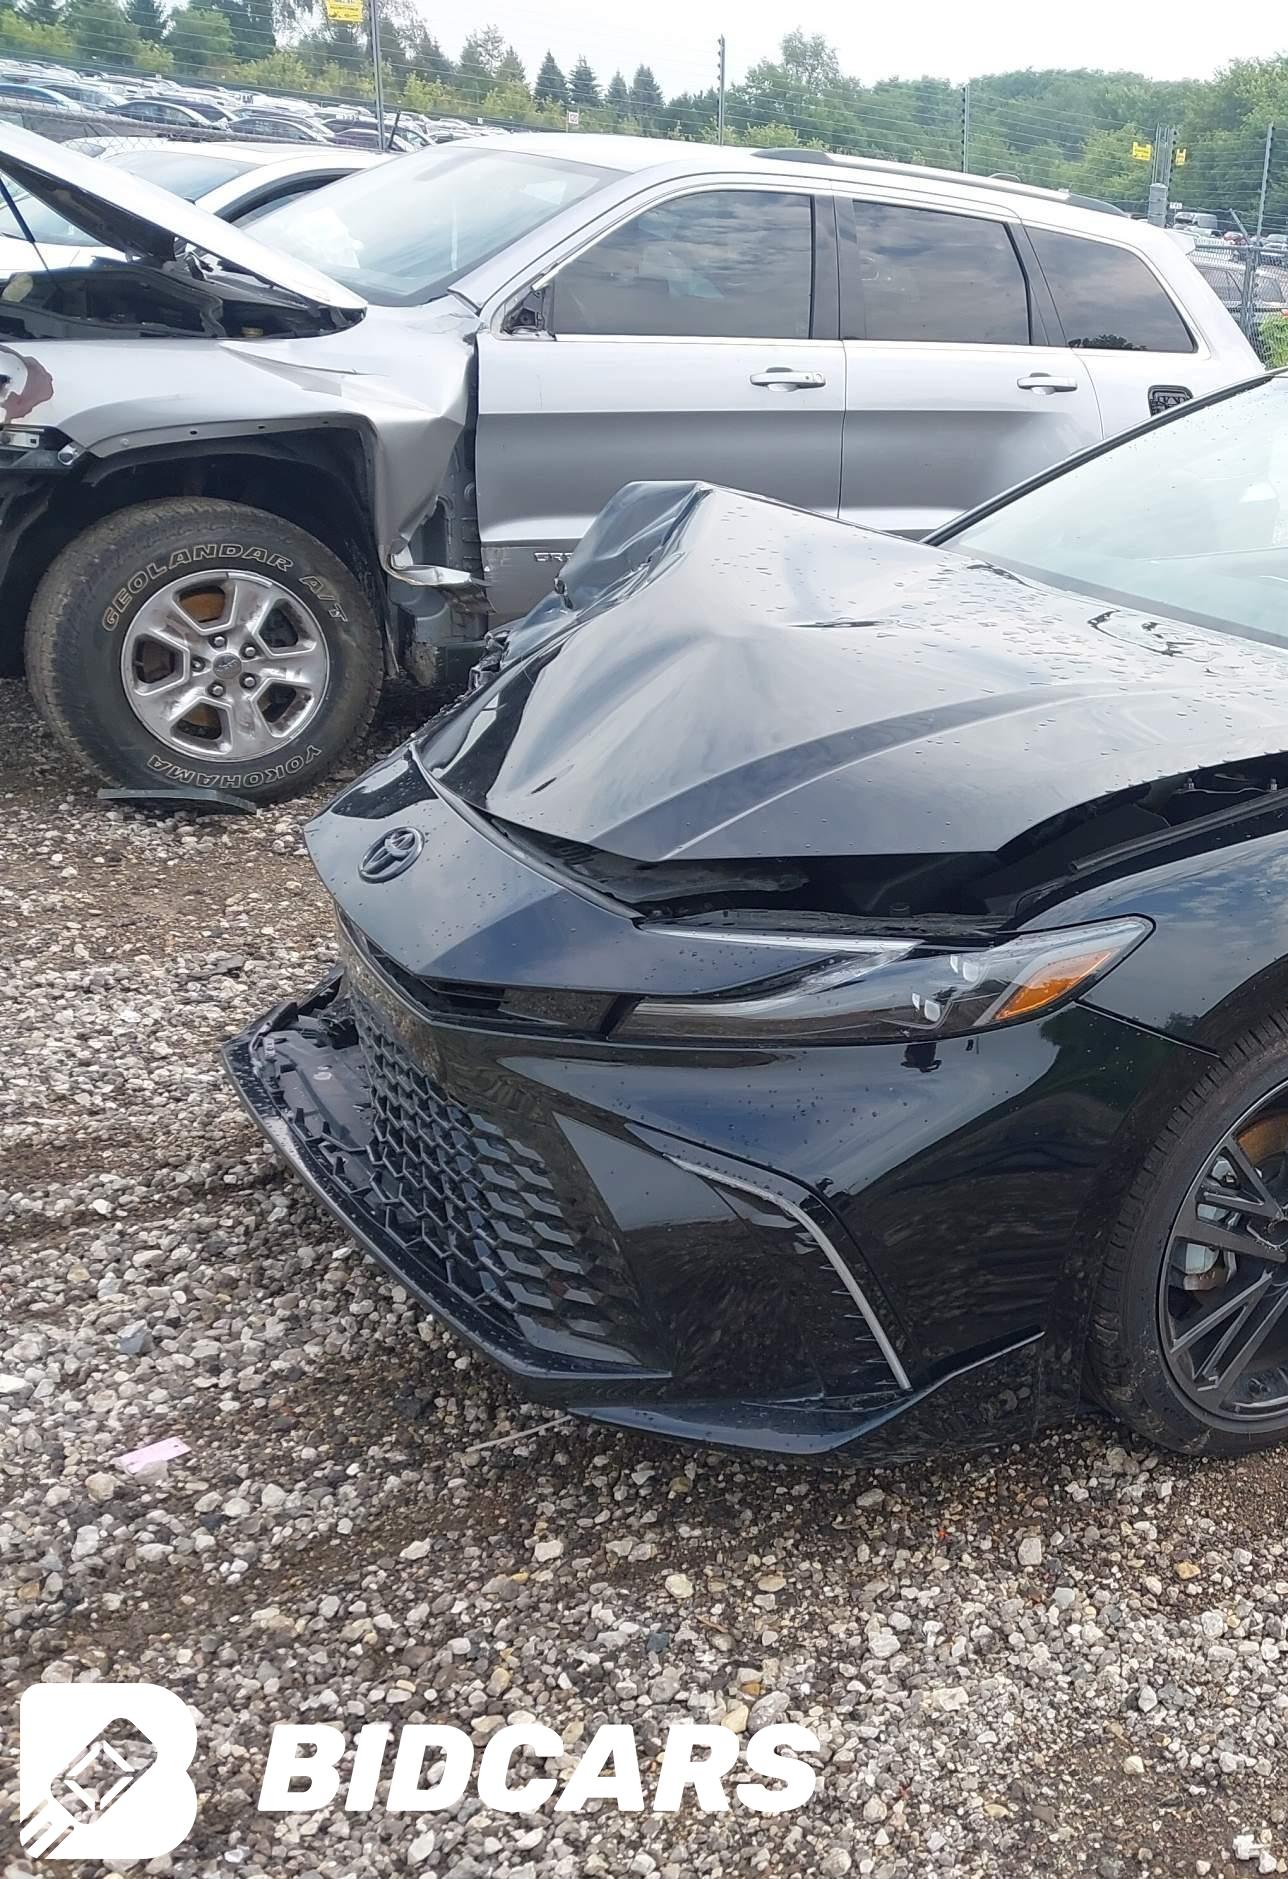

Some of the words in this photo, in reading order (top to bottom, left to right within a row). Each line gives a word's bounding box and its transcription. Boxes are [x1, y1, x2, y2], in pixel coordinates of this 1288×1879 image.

[102, 543, 294, 632] GEOLANDAR
[299, 575, 349, 623] A/T
[146, 744, 322, 789] YOKOHAMA
